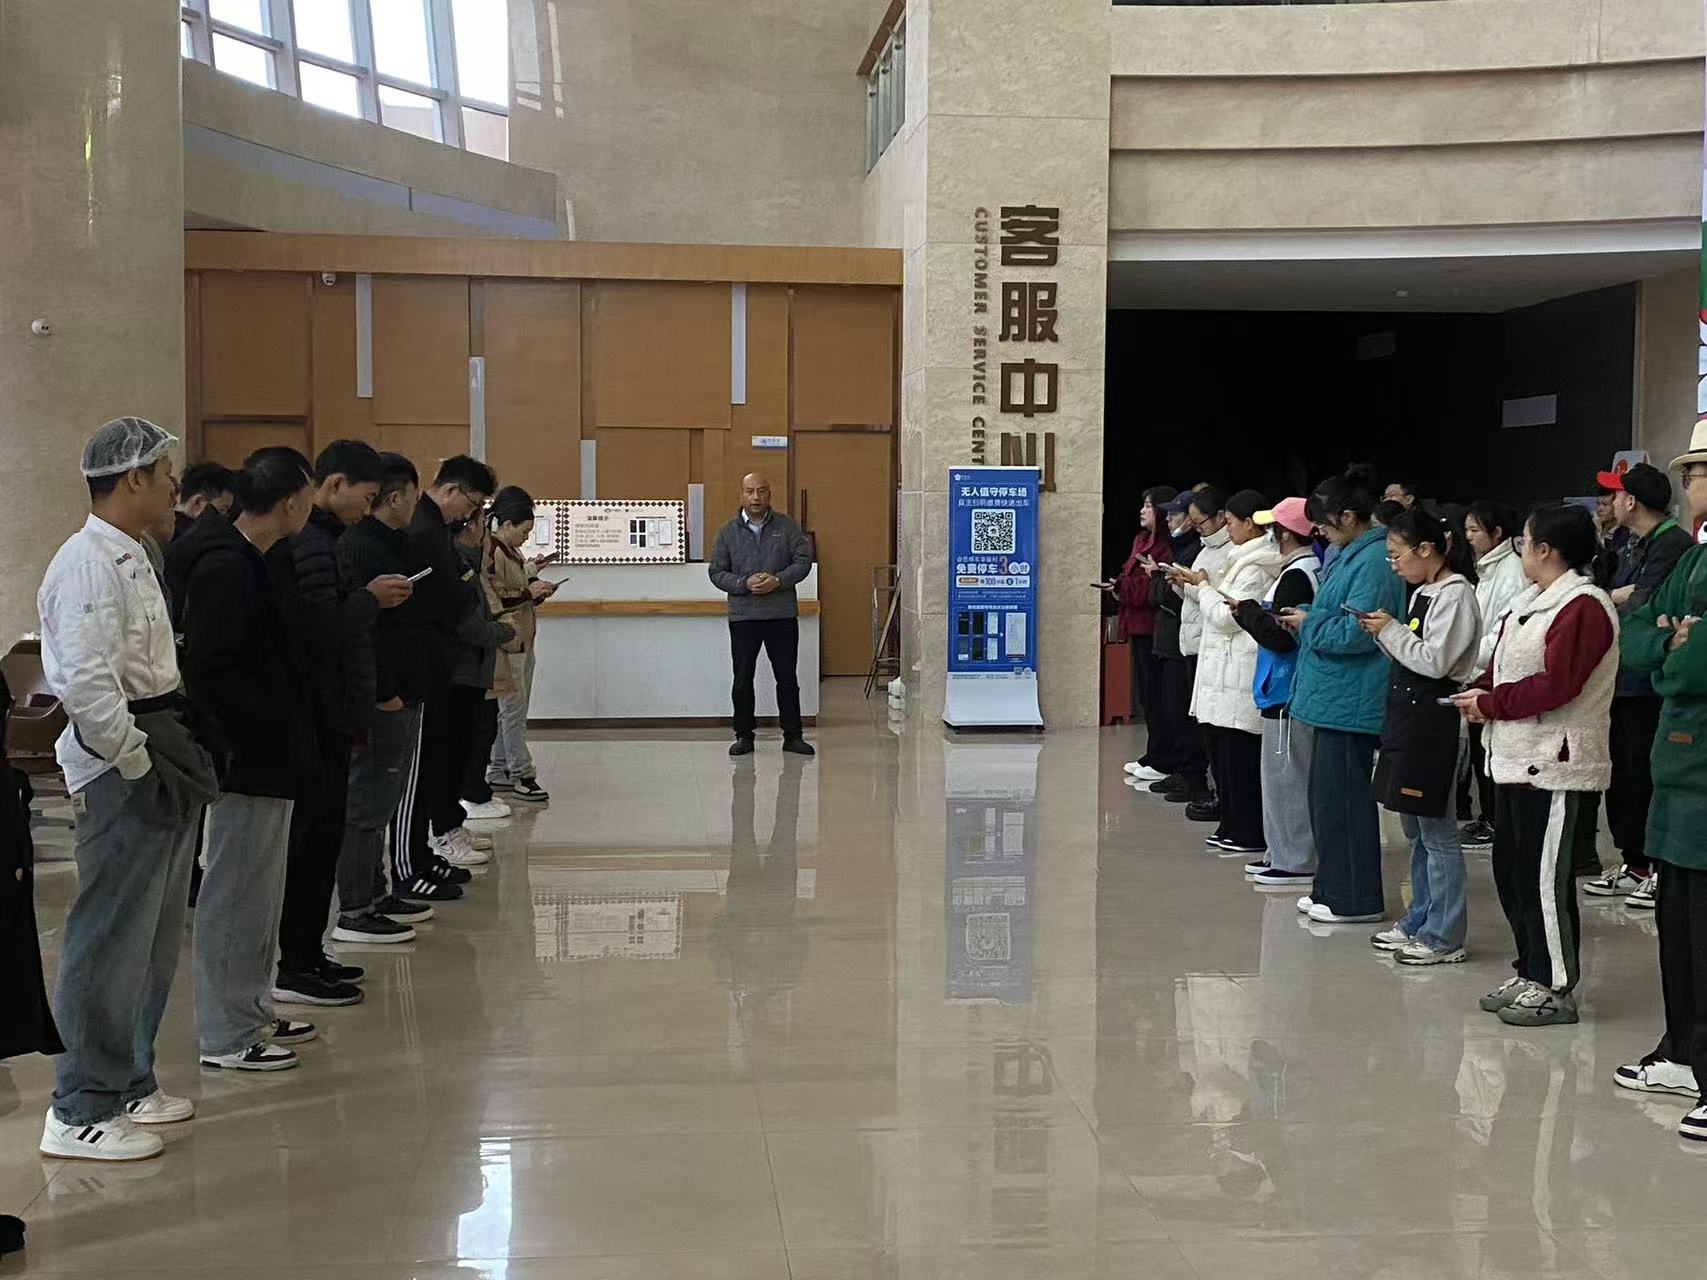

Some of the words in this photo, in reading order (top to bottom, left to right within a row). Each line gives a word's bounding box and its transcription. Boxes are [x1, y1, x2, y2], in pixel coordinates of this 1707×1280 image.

[974, 206, 988, 314] CUSTOMER
[972, 325, 988, 405] SERVICE
[971, 416, 985, 466] CENT
[961, 486, 1027, 497] 无人值守停车场
